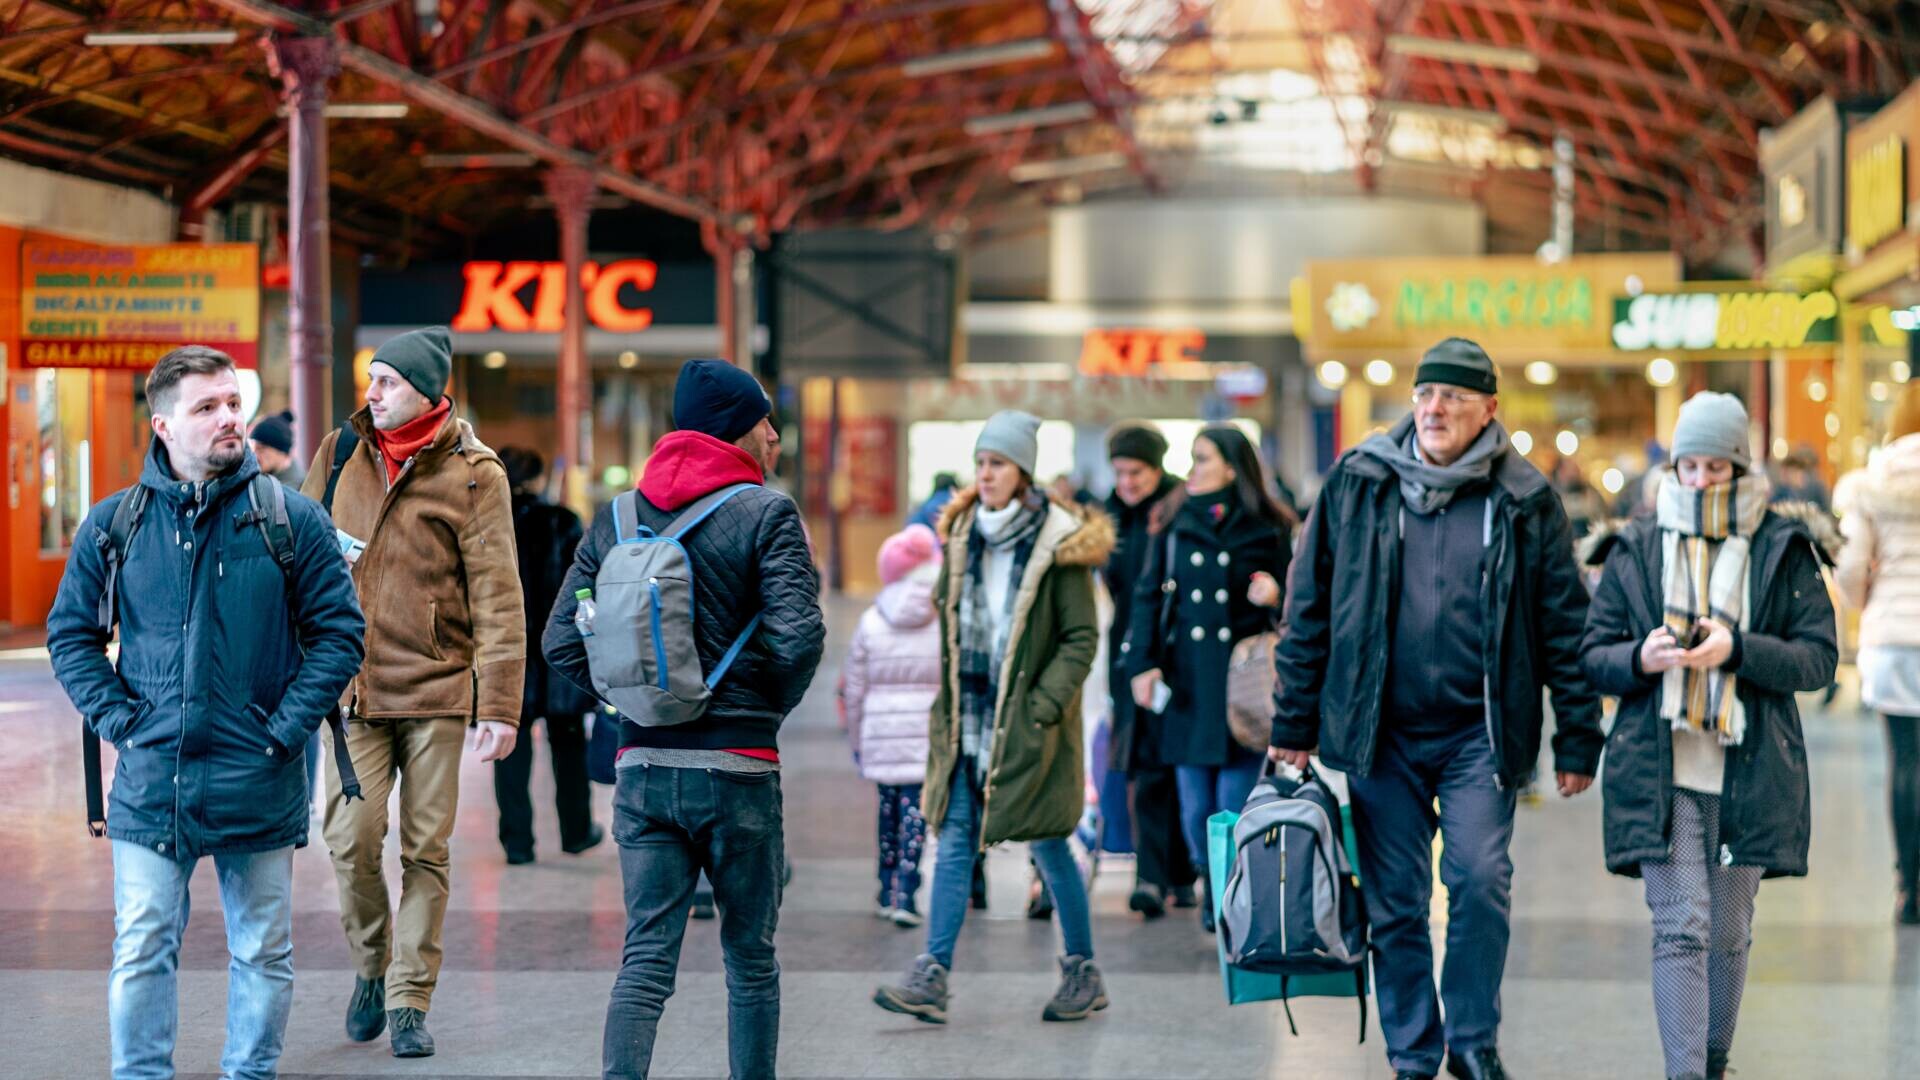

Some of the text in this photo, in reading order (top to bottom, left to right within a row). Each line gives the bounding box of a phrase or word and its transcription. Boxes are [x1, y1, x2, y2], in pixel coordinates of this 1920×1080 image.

[450, 257, 659, 333] KFC
[1394, 274, 1594, 330] NARCISA
[1611, 289, 1838, 350] SUBWAY
[26, 342, 179, 367] GALANTERI
